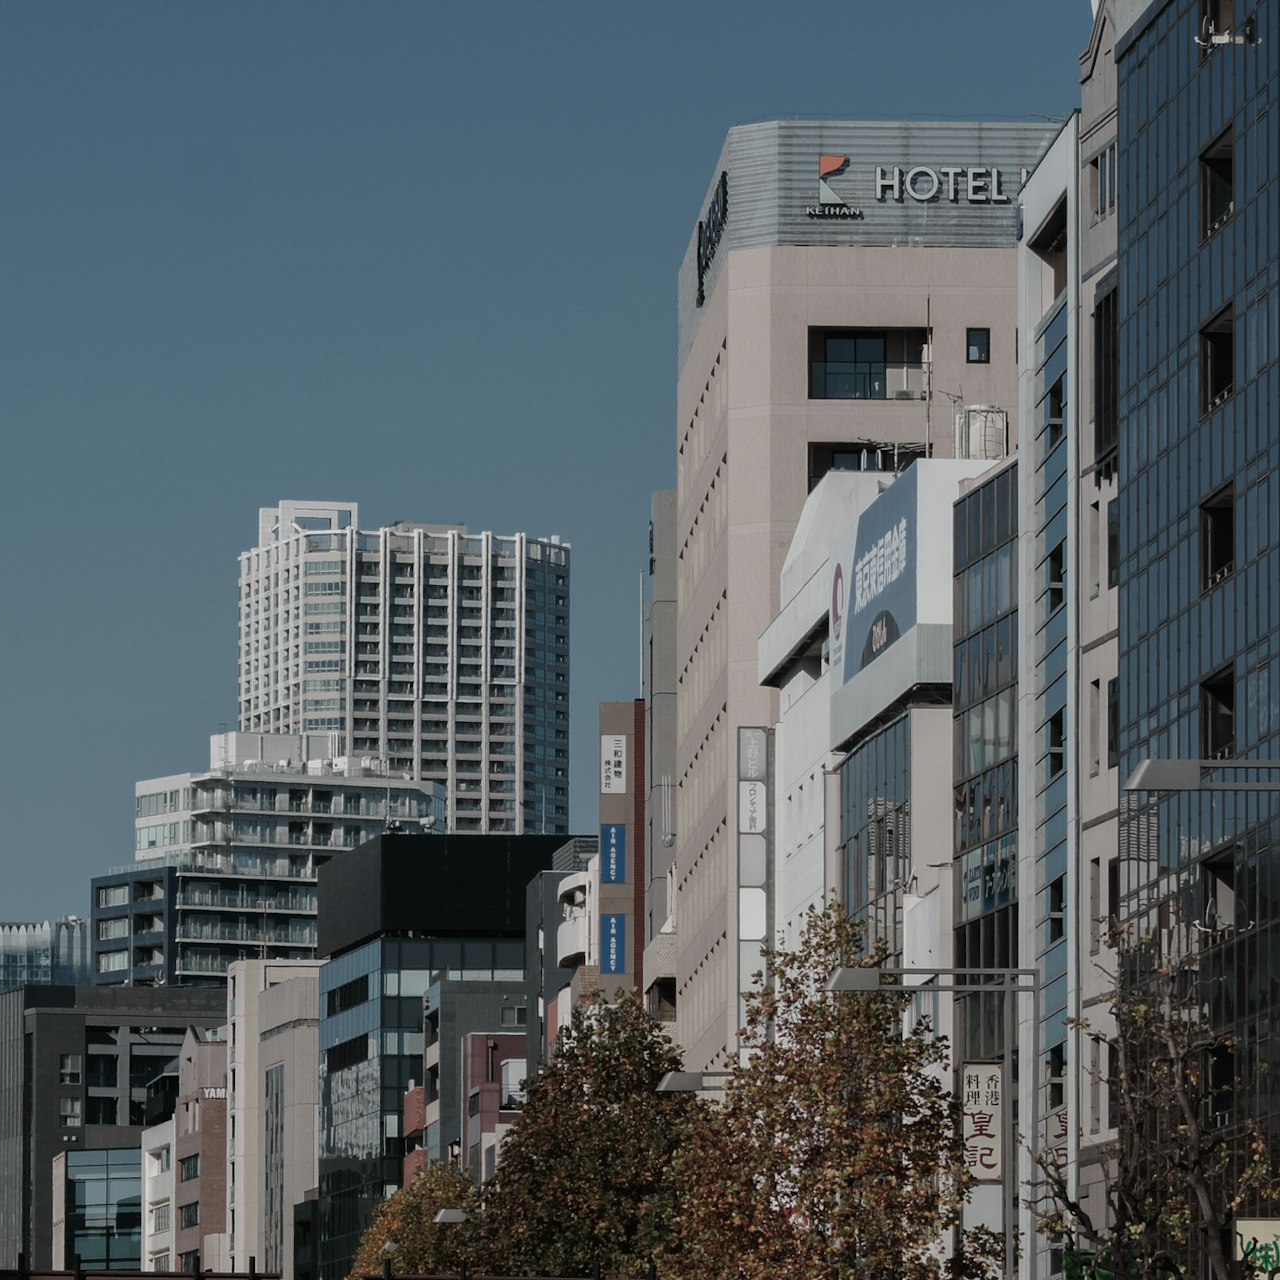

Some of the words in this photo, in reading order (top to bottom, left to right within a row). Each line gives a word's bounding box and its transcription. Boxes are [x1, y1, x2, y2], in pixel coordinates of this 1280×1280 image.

[875, 166, 1008, 201] HOTEL
[806, 206, 860, 216] KEIHAN
[613, 739, 622, 779] 三和建物
[965, 1074, 980, 1105] 料理
[985, 1074, 1000, 1106] 香港
[964, 1110, 998, 1169] 皇記
